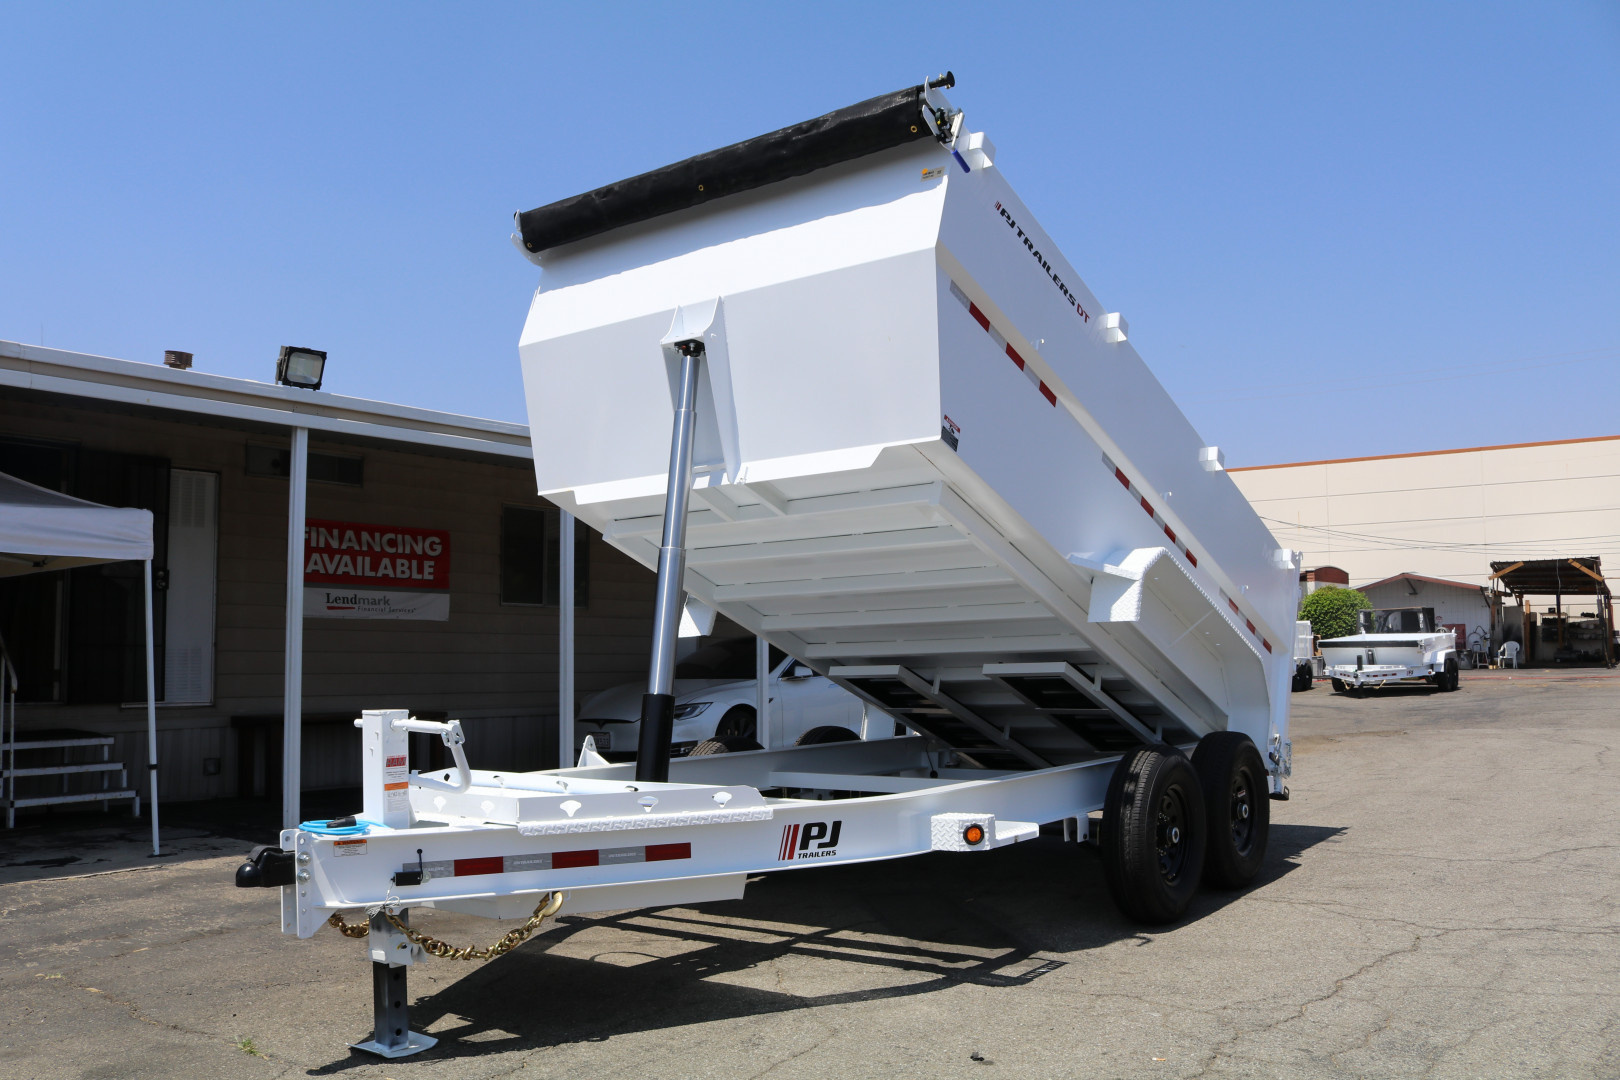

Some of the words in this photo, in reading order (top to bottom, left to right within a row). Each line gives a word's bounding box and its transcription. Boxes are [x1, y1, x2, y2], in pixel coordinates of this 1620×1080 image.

[1000, 208, 1016, 229] PJ
[1017, 225, 1077, 307] TRAILERS
[1076, 303, 1090, 324] DT
[305, 552, 435, 580] AVAILABLE
[325, 592, 391, 606] Lendmark
[799, 820, 842, 850] PJ
[797, 850, 837, 859] TRAILERS
